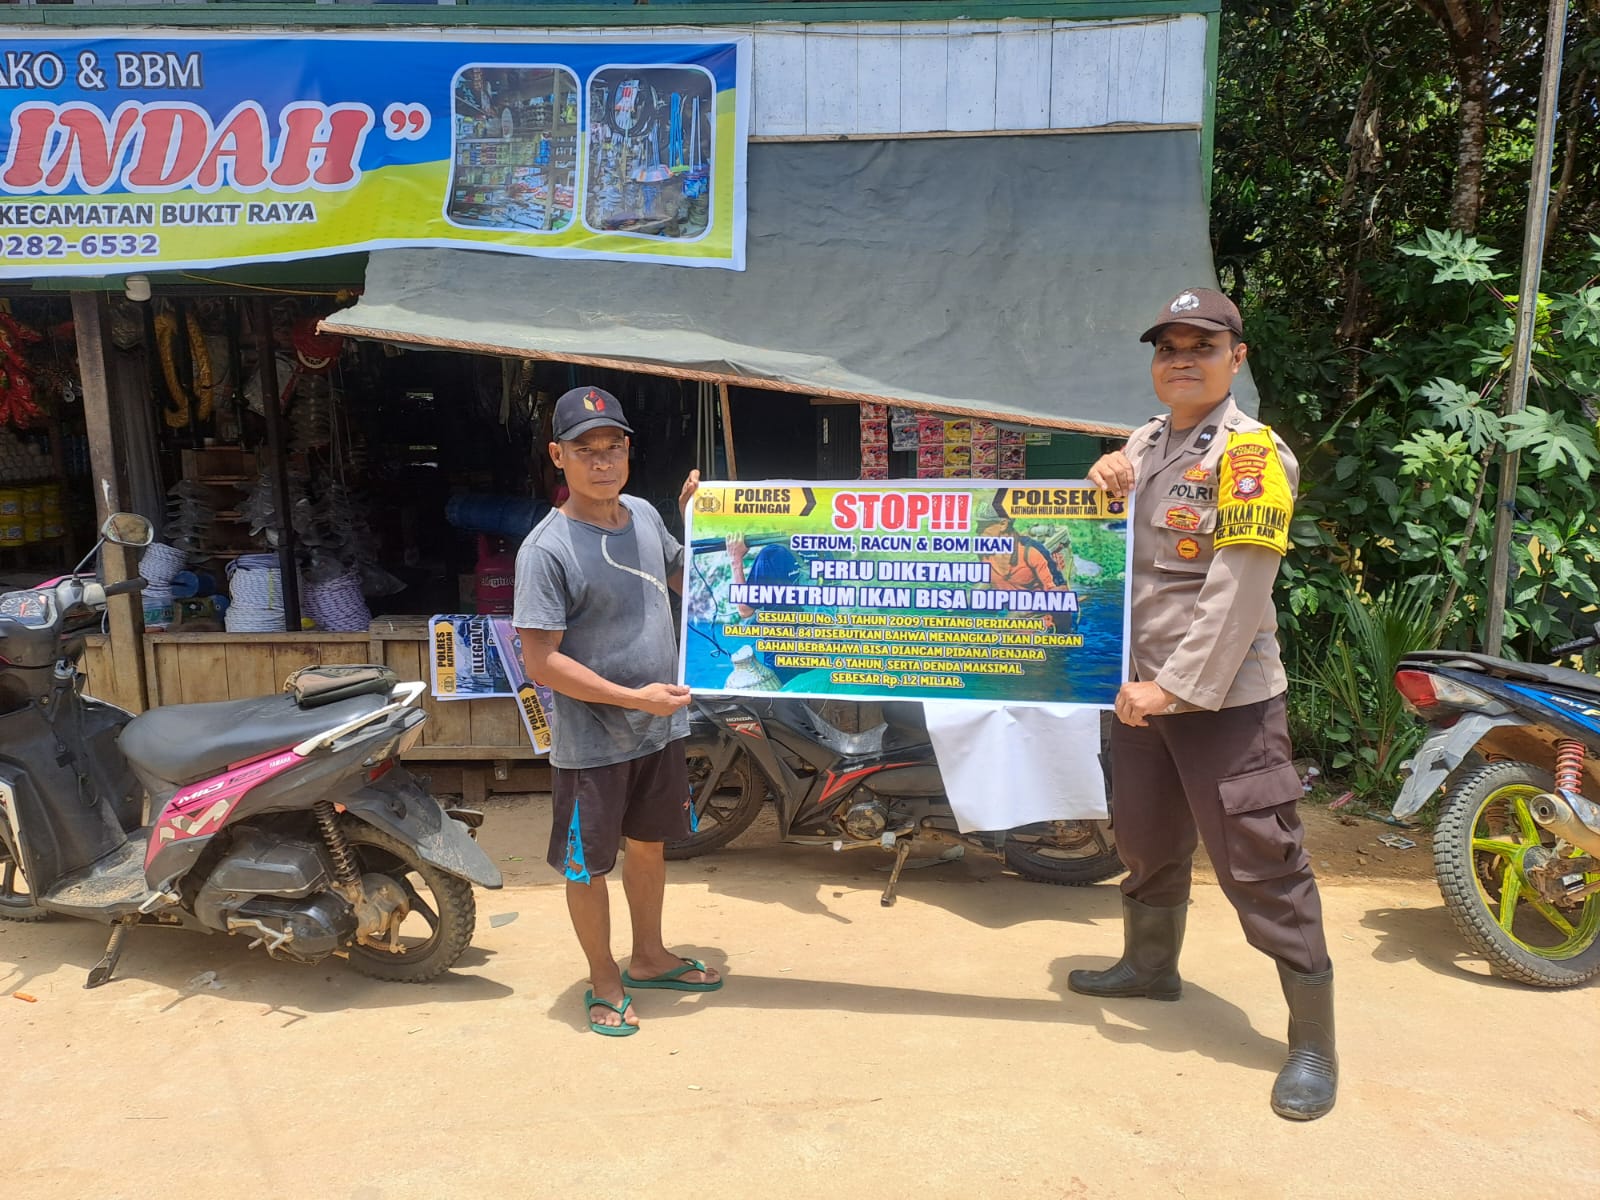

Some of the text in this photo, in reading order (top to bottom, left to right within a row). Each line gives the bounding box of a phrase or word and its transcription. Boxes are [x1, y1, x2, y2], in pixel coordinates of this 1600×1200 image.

[78, 52, 105, 88] &
[117, 54, 201, 87] BBM
[0, 203, 315, 225] KECAMATAN BUKIT RAYA
[735, 489, 790, 502] POLRES
[1012, 490, 1096, 505] POLSEK
[1169, 485, 1213, 500] POLRI
[734, 503, 790, 514] KATINGAN
[834, 493, 970, 531] STOP!!!
[792, 536, 1013, 553] SETRUM, RACUN & BOM IKAN
[811, 561, 990, 582] PERLU DIKETAHUI
[730, 585, 1078, 611] MENYETRUM IKAN BISA DIPIDANA
[758, 613, 796, 623] SESUAI
[799, 613, 813, 623] UU
[837, 614, 848, 625] 31
[851, 615, 887, 626] TAHUN
[890, 616, 920, 627] 2009
[924, 617, 972, 628] TENTANG
[976, 618, 1045, 630] PERIKANAN,
[724, 626, 1082, 645] DALAM PASAL 84 DISEBUTKAN BAHWA MENANGKAP IKAN DENGAN
[436, 632, 446, 667] POLRES
[472, 631, 484, 673] ILLEGAL
[757, 640, 1045, 660] BAHAN BERBAHAYA BISA DIANCAM PIDANA PENJARA
[776, 656, 1022, 674] MAKSIMAL 6 TAHUN, SERTA DENDA MAKSIMAL
[832, 673, 880, 684] SEBESAR
[883, 675, 899, 687] Rp.
[920, 676, 963, 687] MILIAR.
[522, 697, 540, 731] POLRES
